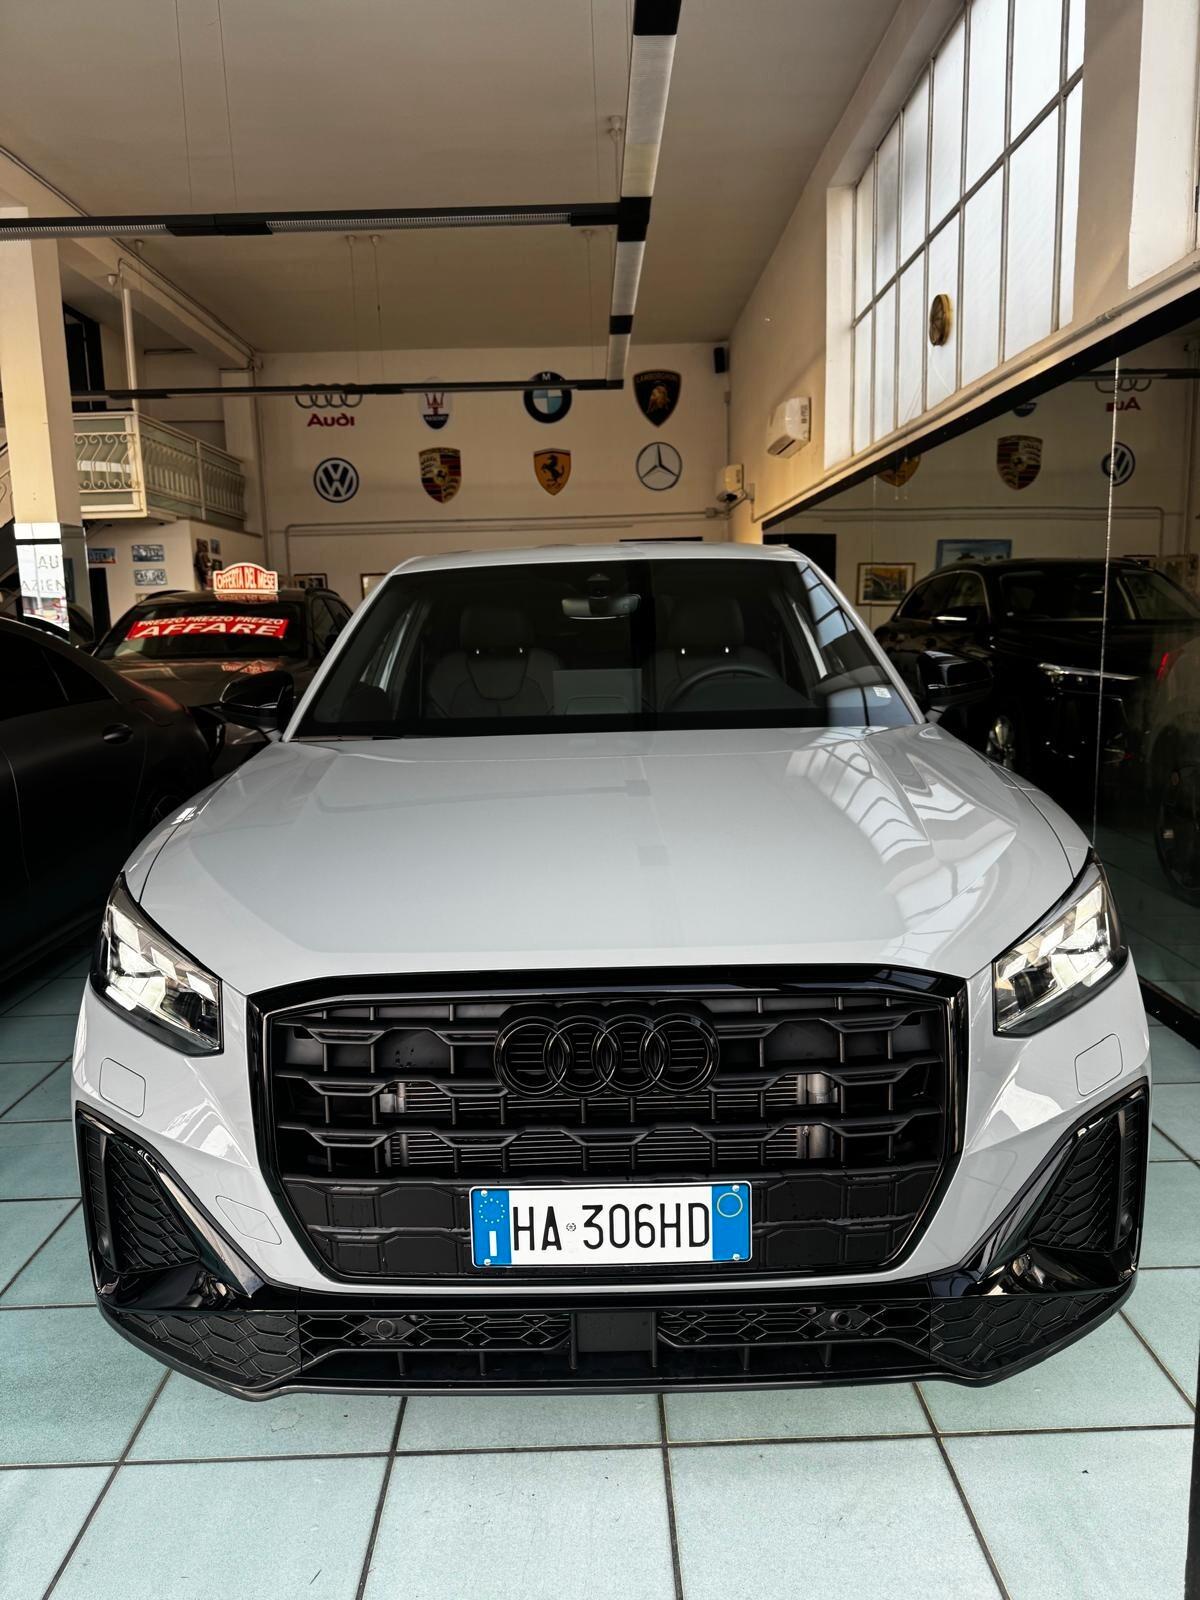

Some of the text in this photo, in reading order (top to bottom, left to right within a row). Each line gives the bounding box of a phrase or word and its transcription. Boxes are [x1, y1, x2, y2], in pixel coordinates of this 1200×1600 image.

[307, 413, 355, 427] Audi
[217, 566, 275, 589] OFFERTA DEL MESE
[137, 617, 185, 626] PREZZO
[236, 616, 284, 625] PREZZO
[133, 622, 281, 638] AFFARE
[513, 1203, 709, 1251] HA 306HD
